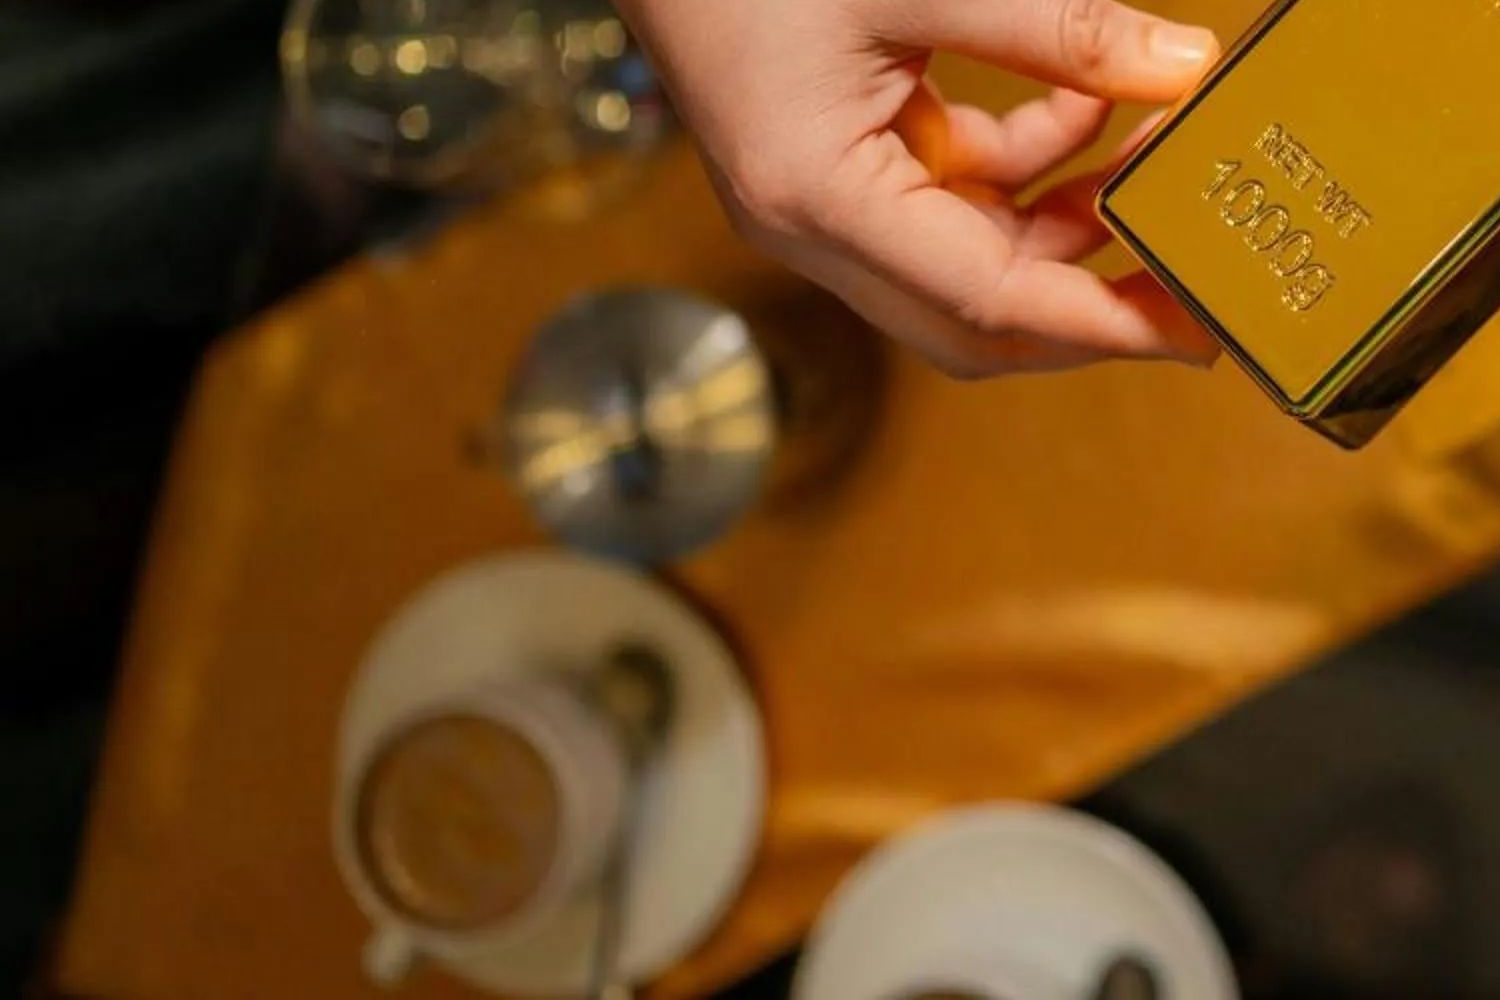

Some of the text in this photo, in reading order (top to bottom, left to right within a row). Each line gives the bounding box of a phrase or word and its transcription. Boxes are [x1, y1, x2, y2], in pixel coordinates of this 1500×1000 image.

[1200, 160, 1336, 312] 1000g
[1254, 122, 1373, 239] NET WT
